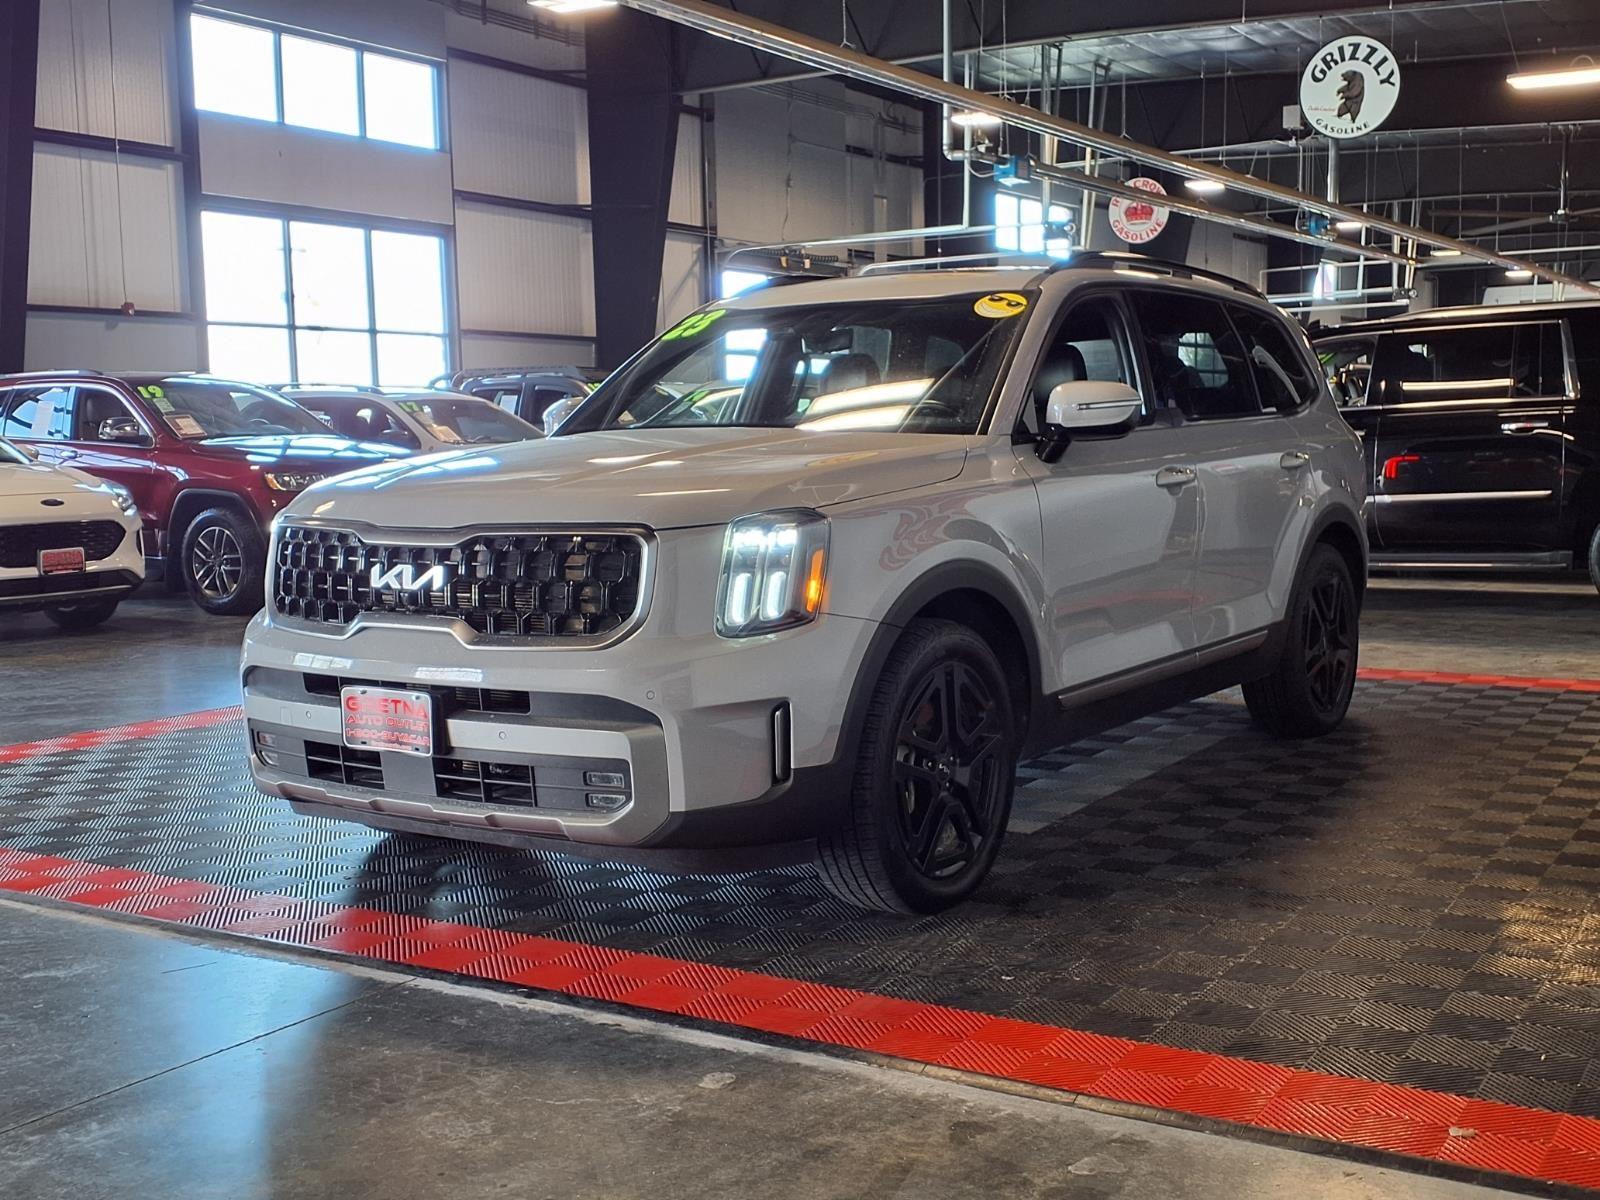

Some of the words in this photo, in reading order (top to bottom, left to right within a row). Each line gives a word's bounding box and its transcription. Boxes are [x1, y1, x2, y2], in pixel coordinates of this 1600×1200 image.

[1311, 42, 1396, 87] GRIZZLY
[1315, 118, 1369, 135] GASOLINE
[1112, 218, 1164, 242] GASOLINE
[661, 308, 726, 341] 23
[137, 385, 164, 398] 19
[370, 562, 444, 591] KIA
[345, 695, 428, 719] GETNA
